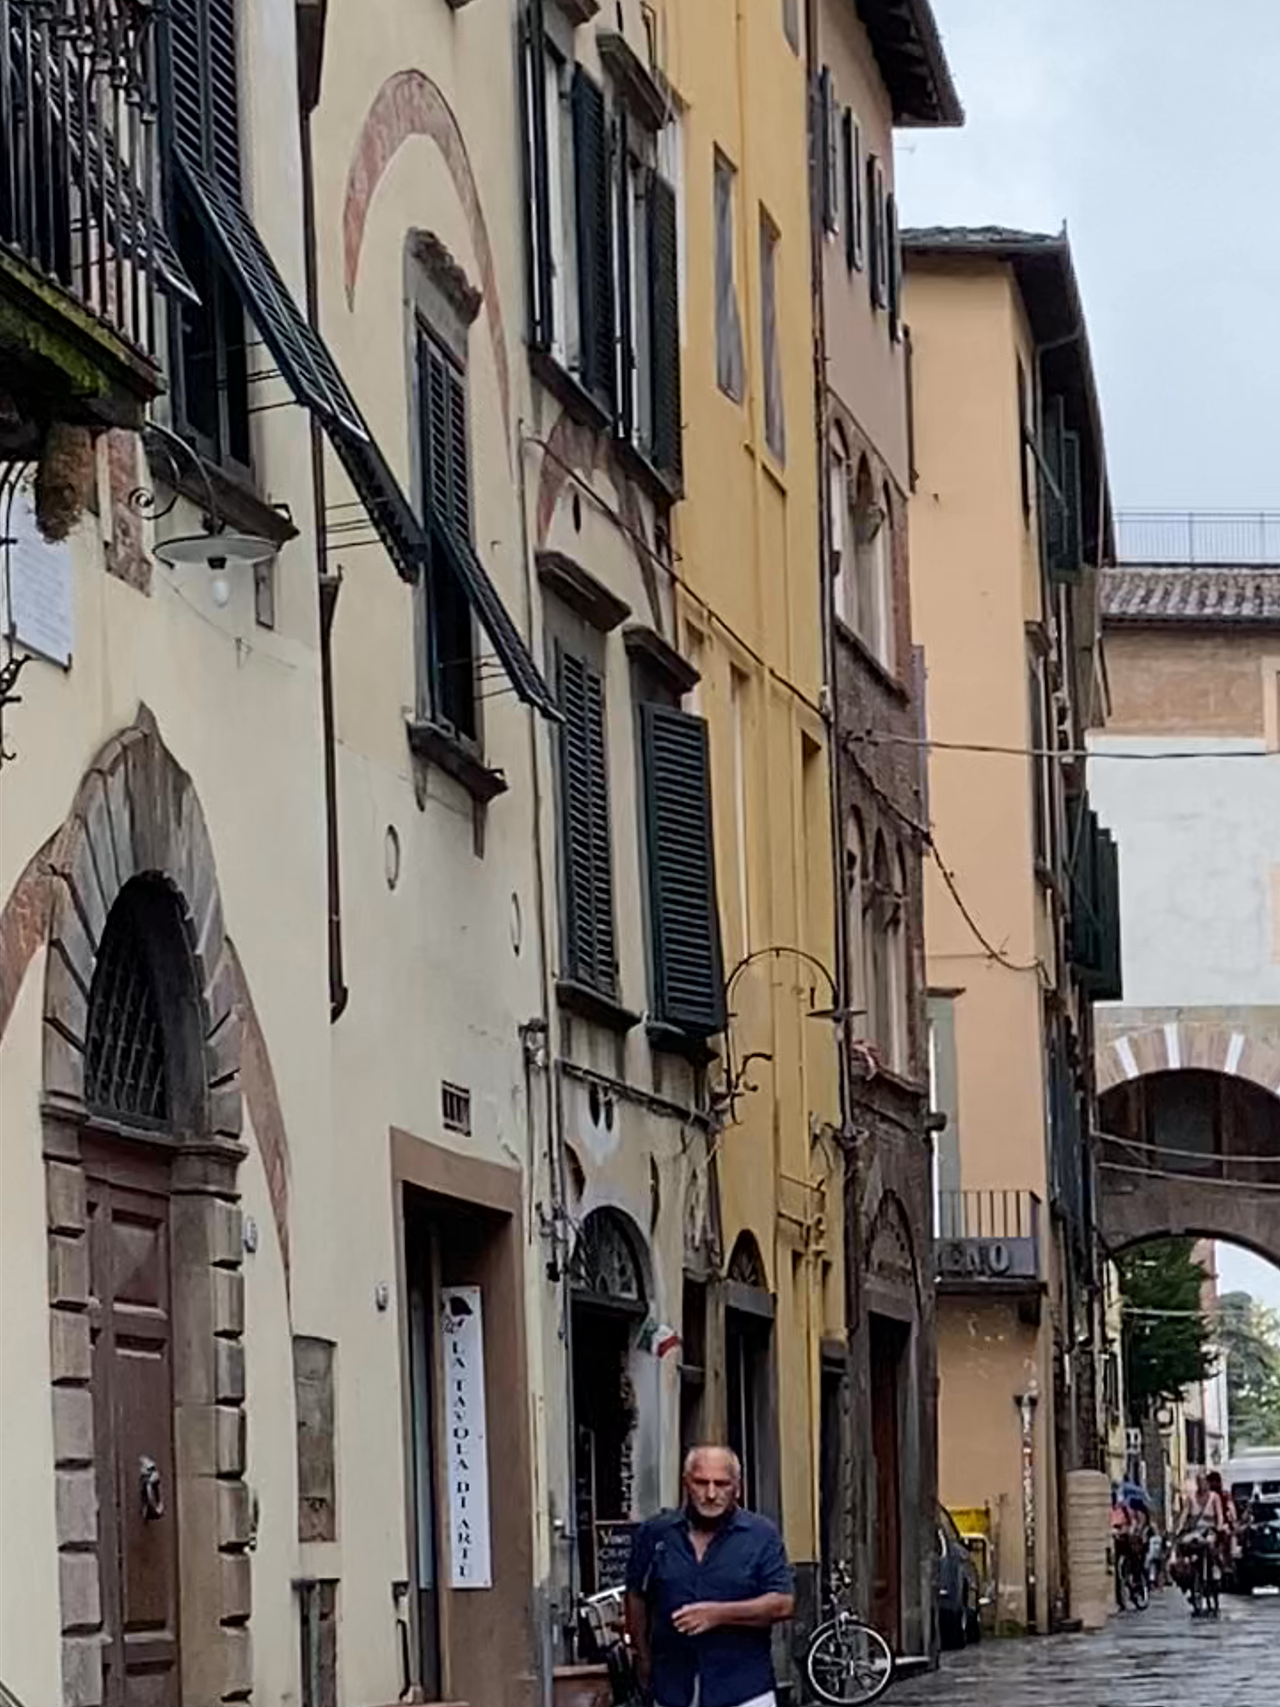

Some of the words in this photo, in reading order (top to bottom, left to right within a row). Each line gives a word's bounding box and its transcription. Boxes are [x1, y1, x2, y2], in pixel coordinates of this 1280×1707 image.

[451, 1340, 466, 1369] LA
[453, 1379, 470, 1470] TAVOLA
[456, 1480, 471, 1509] DI
